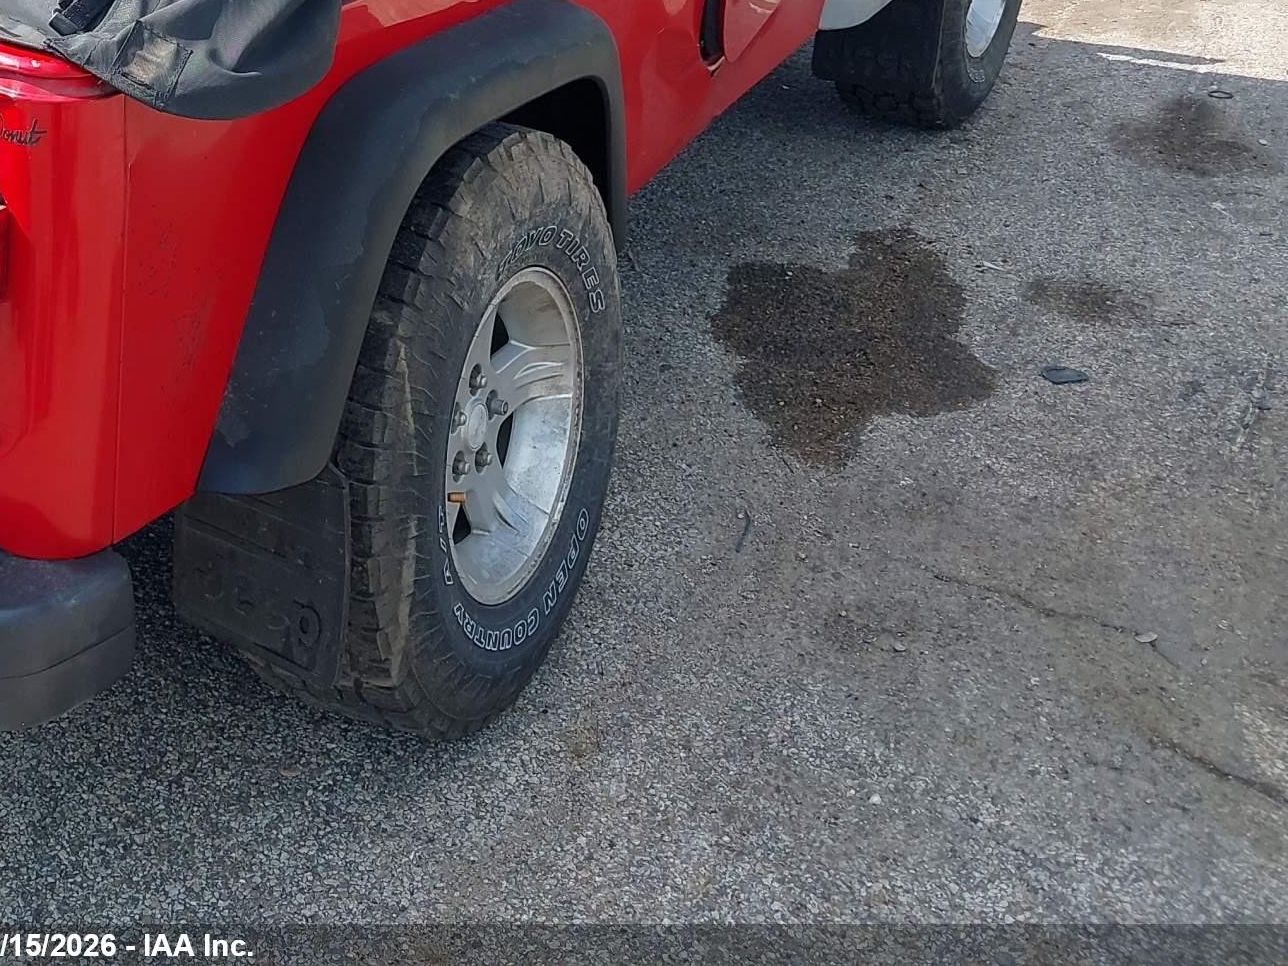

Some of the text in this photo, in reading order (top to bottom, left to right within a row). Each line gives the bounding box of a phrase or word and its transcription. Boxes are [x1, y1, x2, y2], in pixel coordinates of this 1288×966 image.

[495, 225, 606, 314] TOYO TIRES
[542, 507, 590, 616] OPEN
[453, 602, 541, 652] COUNTRY
